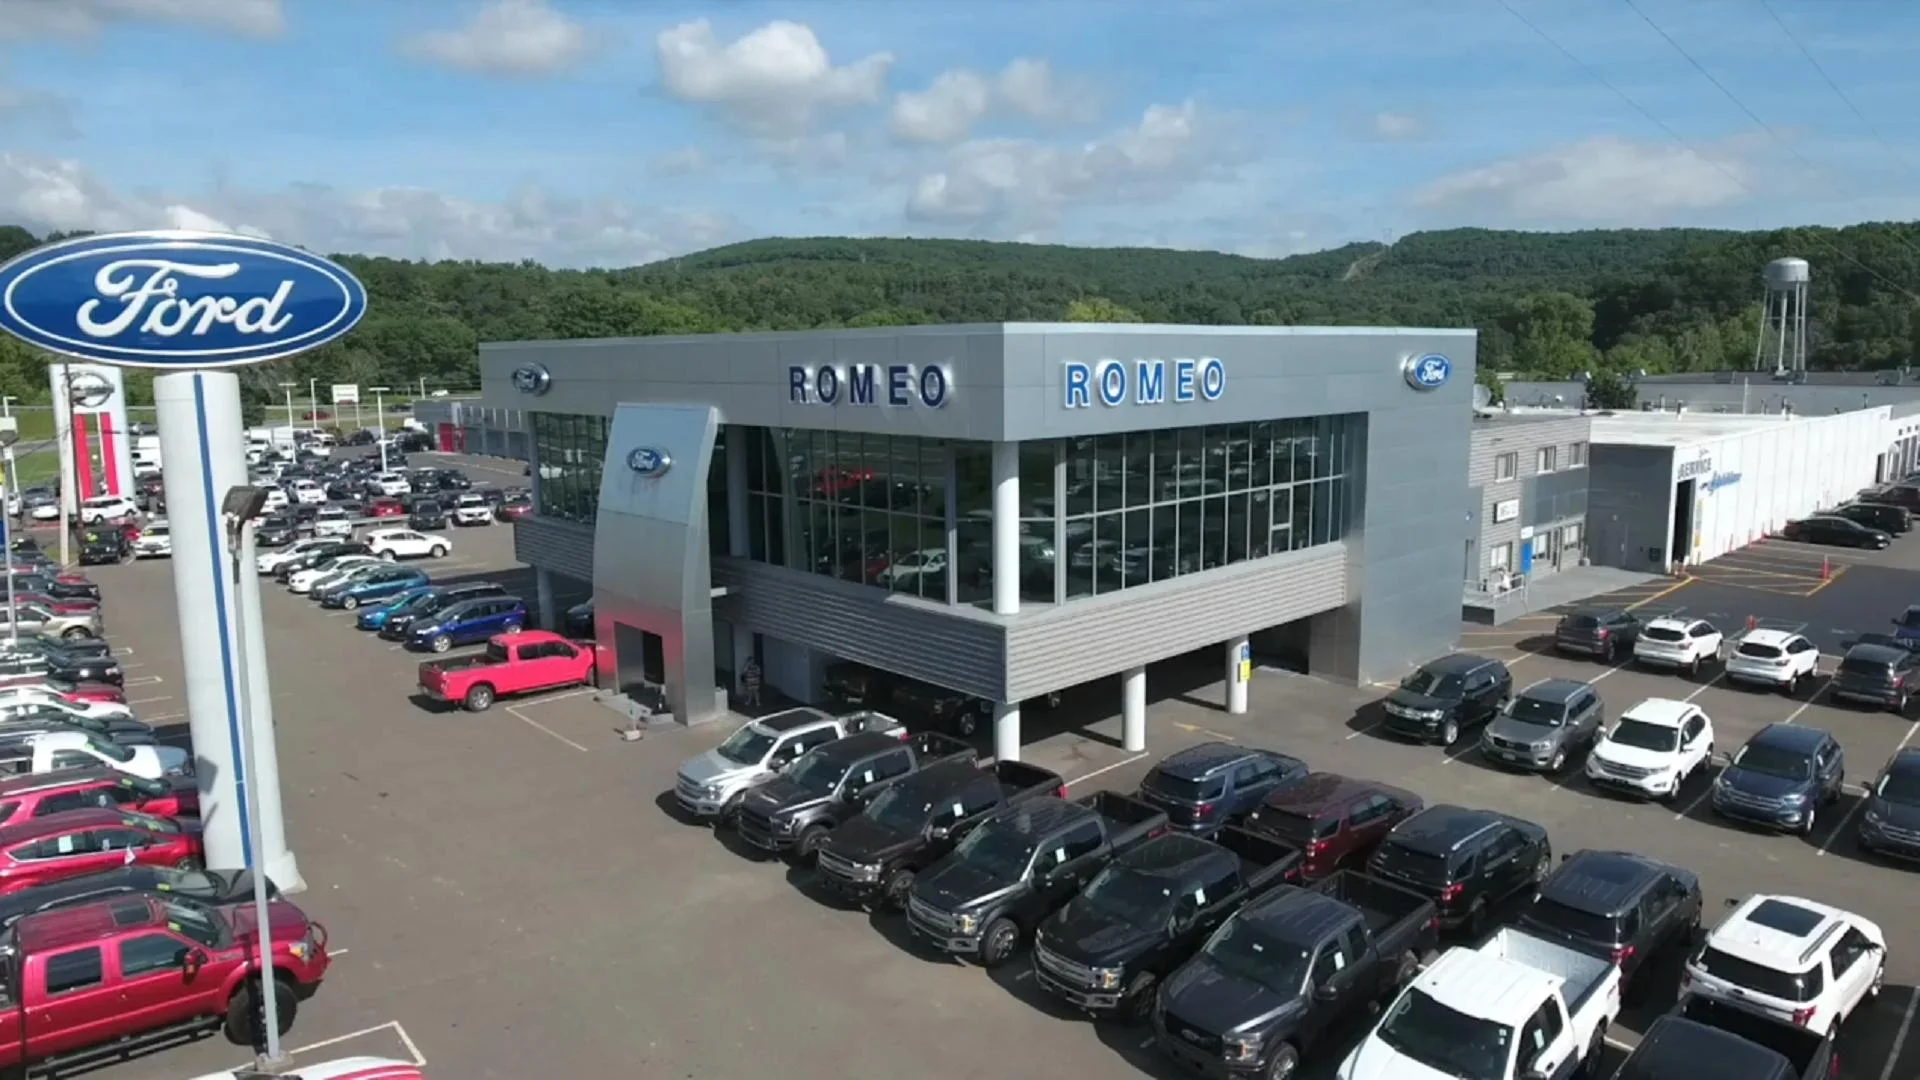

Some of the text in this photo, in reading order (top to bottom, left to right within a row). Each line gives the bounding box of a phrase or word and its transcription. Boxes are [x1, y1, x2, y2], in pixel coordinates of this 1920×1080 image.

[76, 259, 295, 337] Ford
[788, 363, 947, 408] ROMEO
[1065, 358, 1226, 408] ROMEO
